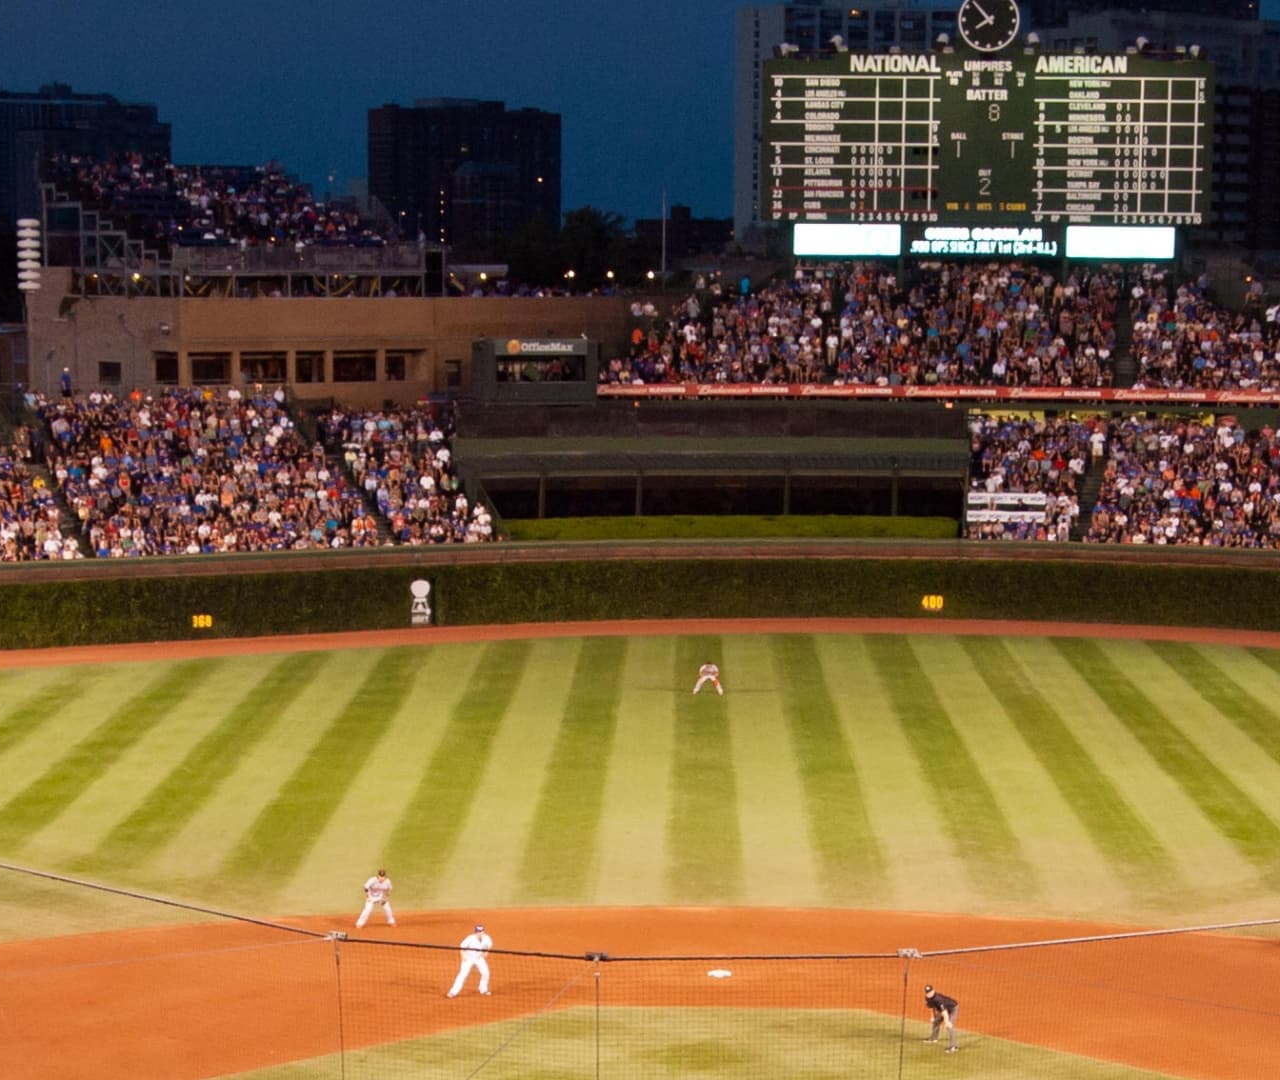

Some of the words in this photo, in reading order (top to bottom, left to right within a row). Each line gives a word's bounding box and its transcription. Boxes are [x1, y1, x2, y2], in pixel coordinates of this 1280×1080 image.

[850, 55, 941, 72] NATIONAL
[964, 61, 1012, 71] UMPIRES
[1035, 56, 1127, 73] AMERICAN
[820, 78, 840, 87] DIEGO
[966, 89, 1008, 100] BATTER
[831, 101, 845, 109] CITY
[1069, 103, 1106, 111] CLEVELAND
[805, 112, 840, 120] COLORADO
[989, 104, 1000, 121] 8
[951, 132, 966, 140] BALL
[804, 168, 831, 176] ATLANTA
[979, 178, 990, 195] 2
[1066, 204, 1094, 212] CHICAGO
[950, 241, 974, 253] SINCE
[976, 241, 997, 253] JULY
[521, 342, 573, 352] OfficeMax
[922, 595, 943, 608] 400
